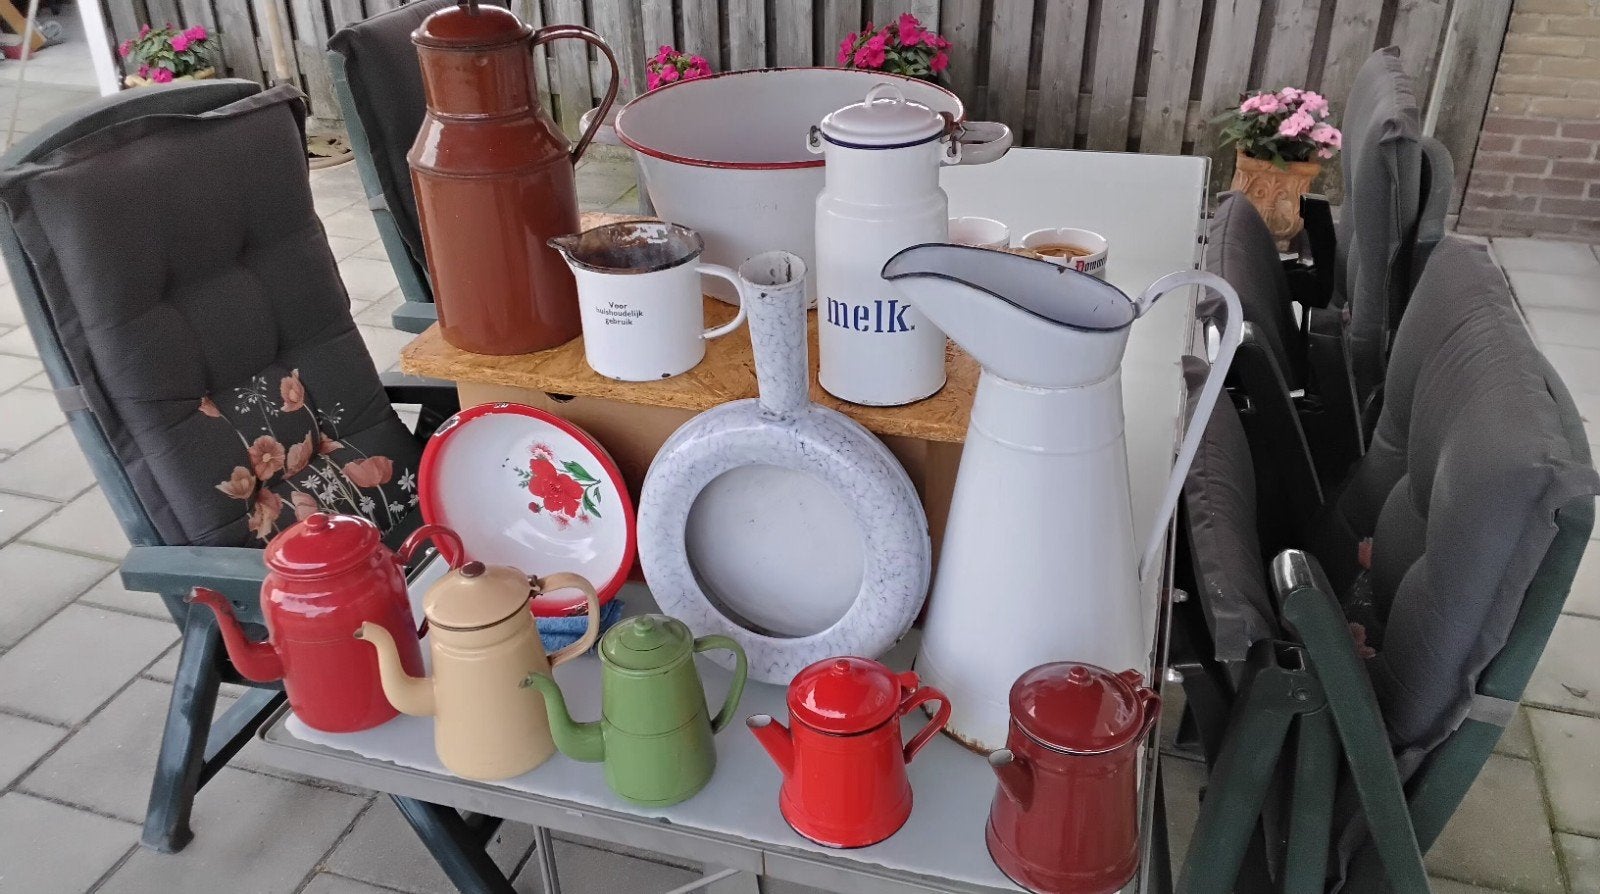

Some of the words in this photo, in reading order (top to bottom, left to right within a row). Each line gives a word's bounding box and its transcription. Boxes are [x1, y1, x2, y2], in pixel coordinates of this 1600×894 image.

[608, 301, 628, 310] Voor
[596, 305, 644, 319] huishoudelijk
[605, 317, 633, 326] gebruik
